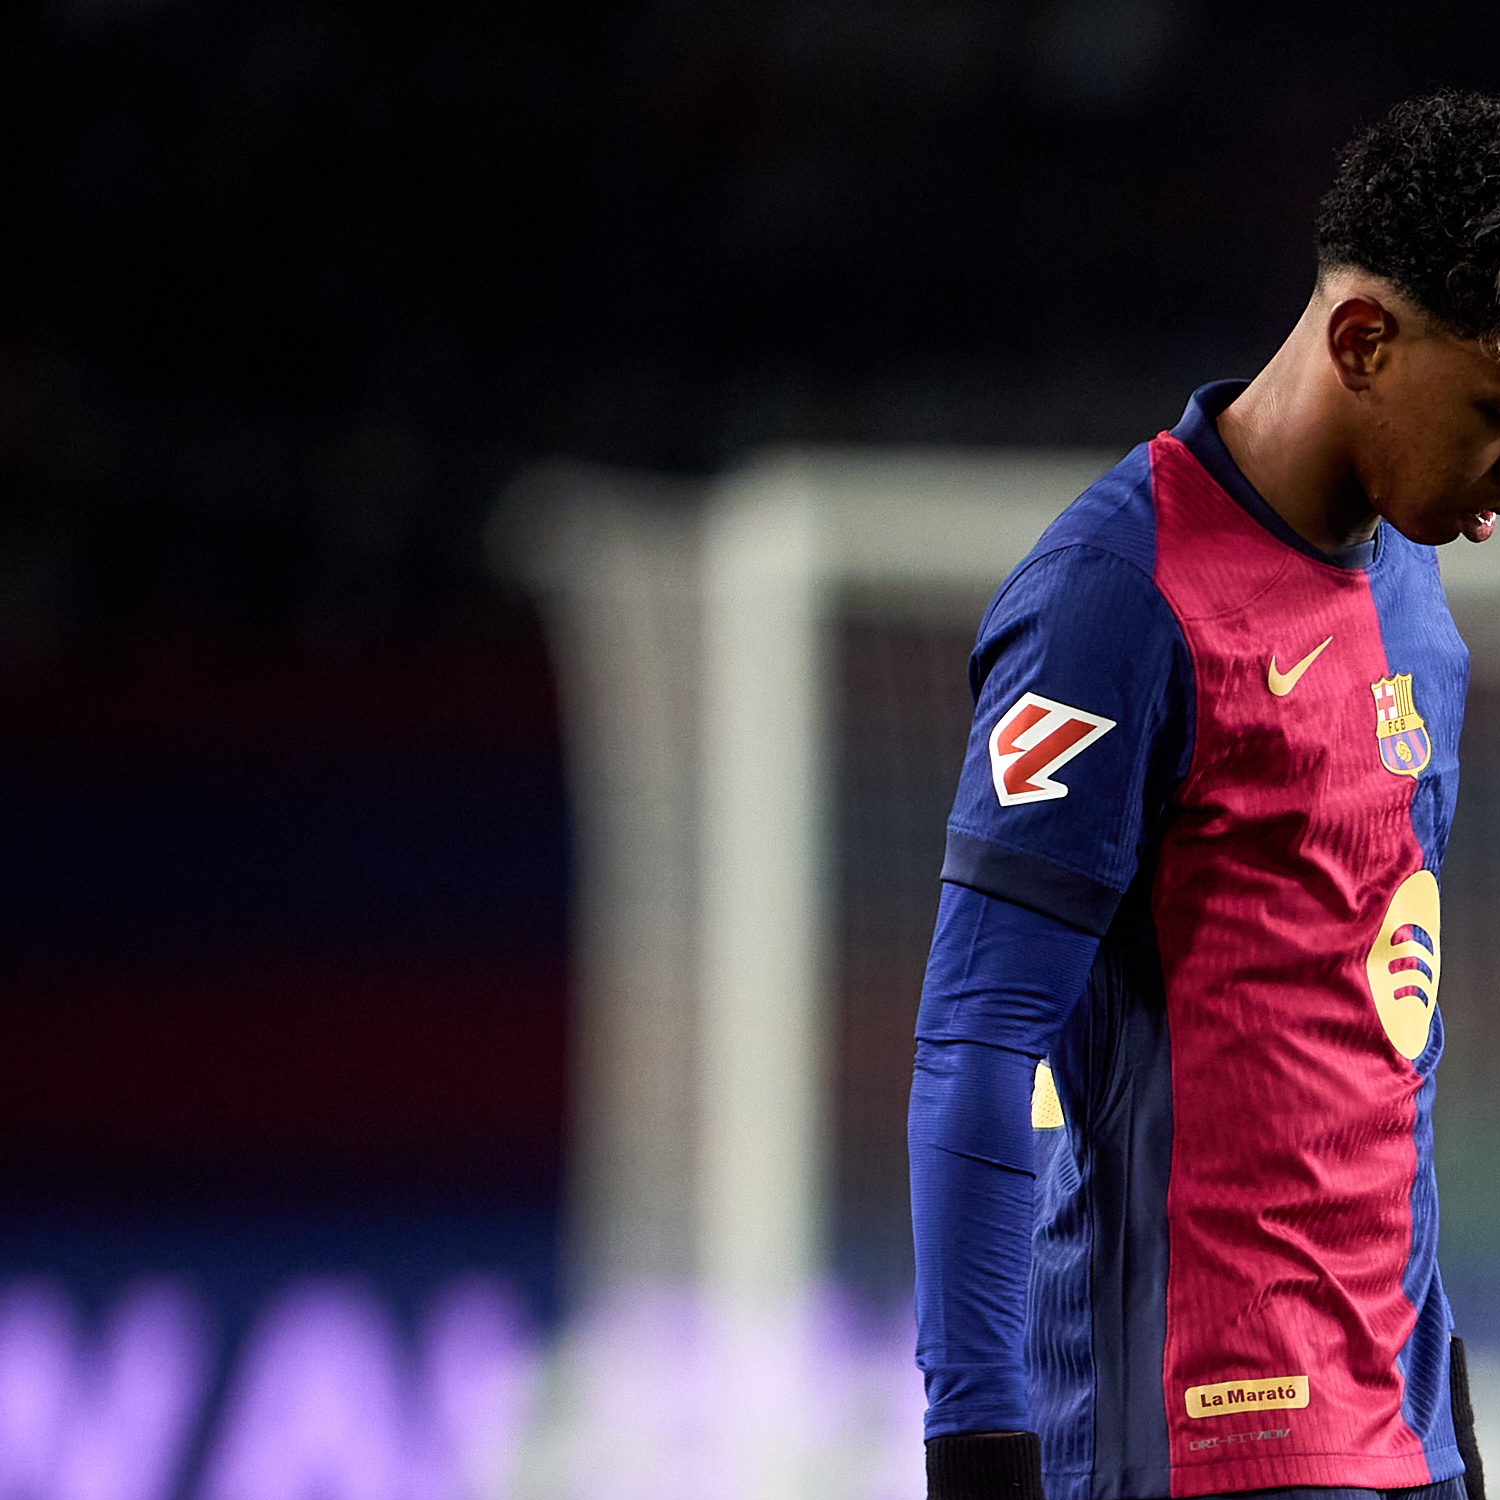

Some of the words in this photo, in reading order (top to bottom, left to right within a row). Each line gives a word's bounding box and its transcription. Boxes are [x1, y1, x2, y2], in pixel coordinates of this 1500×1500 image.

[1387, 718, 1407, 734] FCB
[1200, 1393, 1223, 1408] La
[1227, 1384, 1296, 1404] Marató
